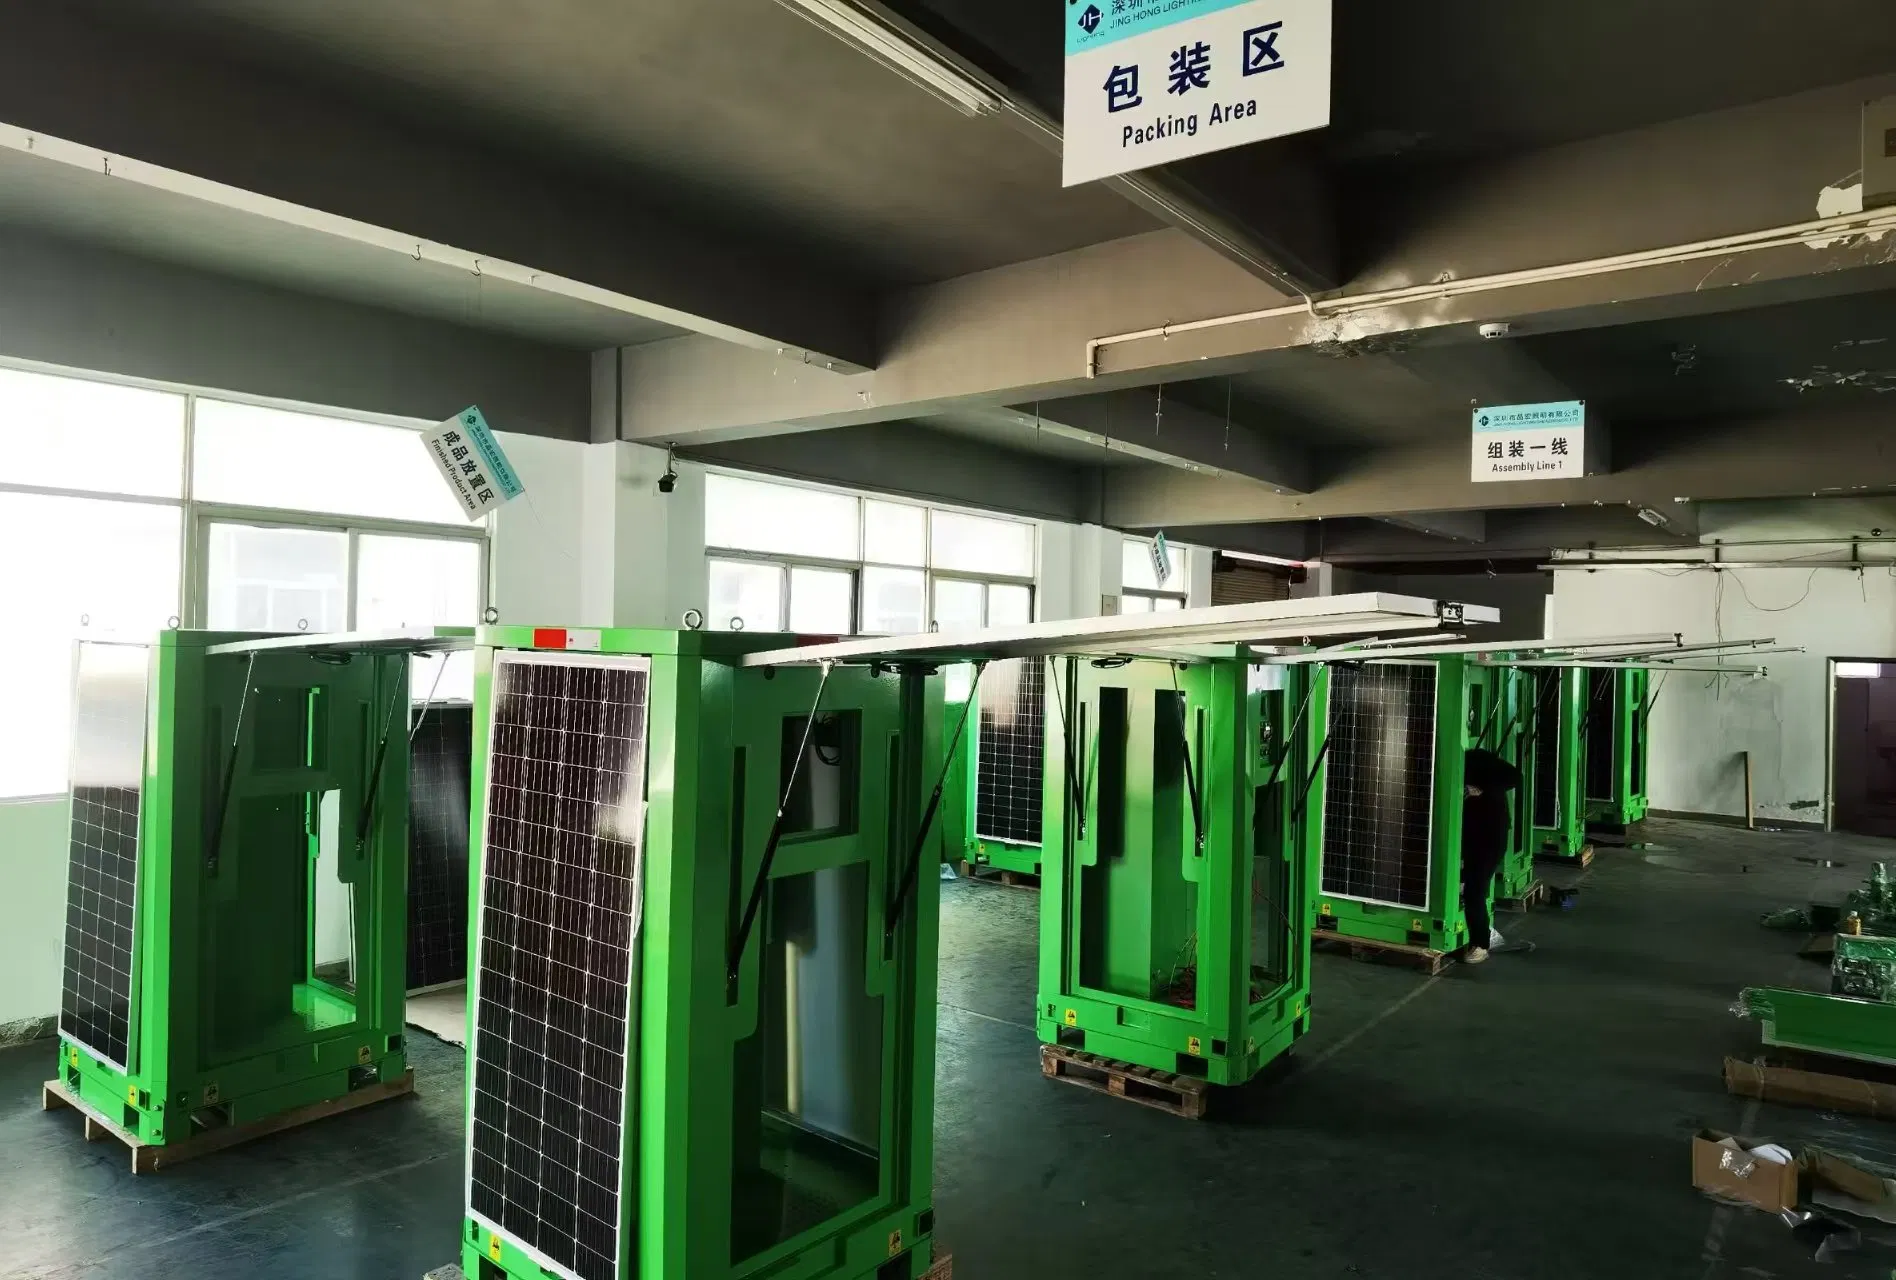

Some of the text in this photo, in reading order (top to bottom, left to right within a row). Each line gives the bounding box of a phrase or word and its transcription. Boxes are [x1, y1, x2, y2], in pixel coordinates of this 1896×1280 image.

[1110, 14, 1131, 29] JING
[1133, 7, 1160, 22] HONG
[1102, 20, 1285, 113] 包装区
[1122, 99, 1257, 148] Packing Area
[442, 430, 495, 505] 成品放置区
[1487, 437, 1569, 459] 组装一线
[1491, 461, 1535, 473] Assembly
[1537, 460, 1556, 470] Line
[431, 438, 477, 510] Finished Product Area
